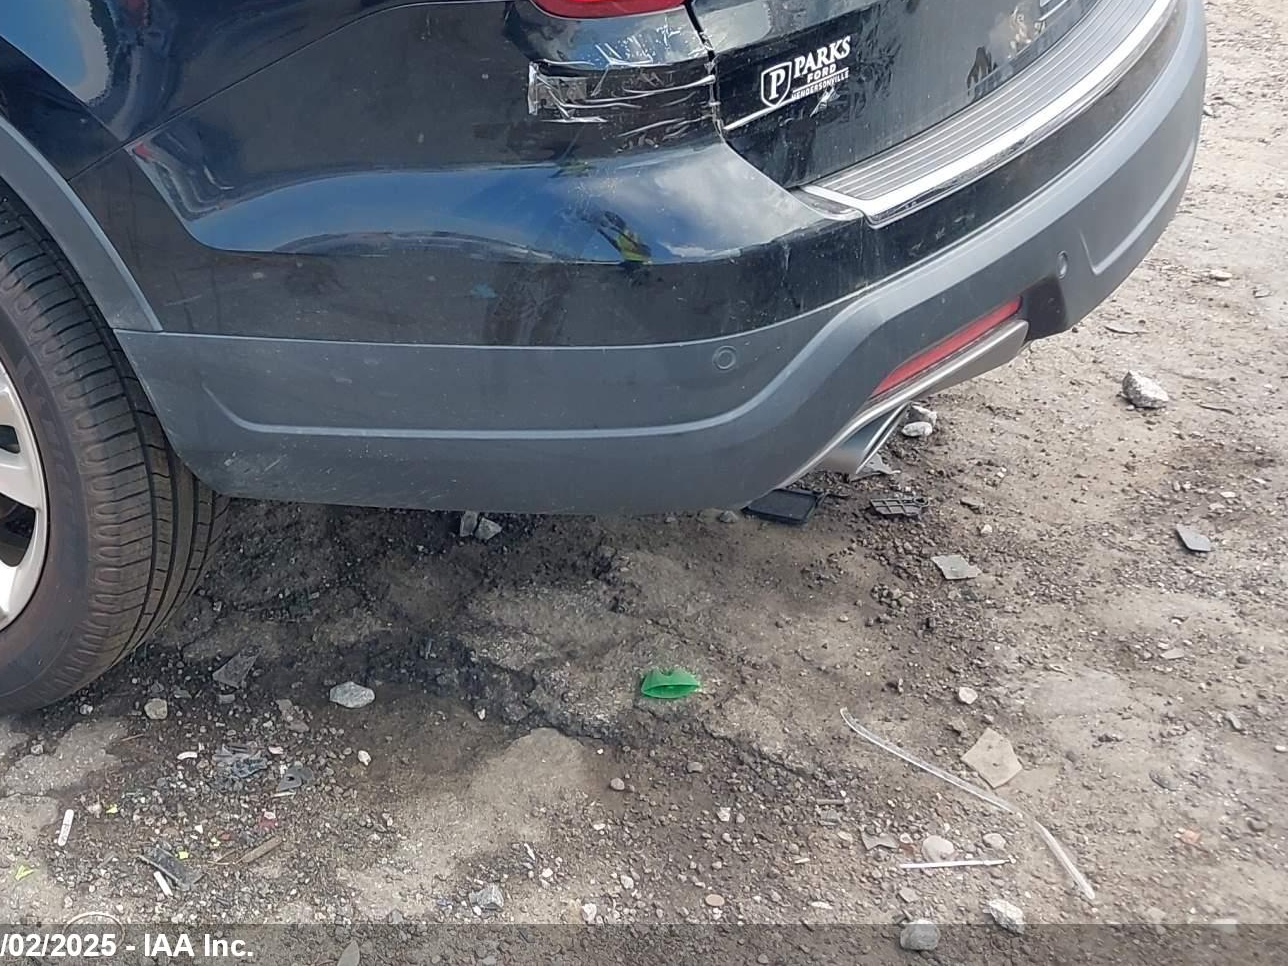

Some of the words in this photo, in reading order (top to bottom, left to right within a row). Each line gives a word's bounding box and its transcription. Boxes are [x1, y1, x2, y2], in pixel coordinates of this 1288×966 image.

[793, 35, 851, 79] PARKS
[768, 68, 786, 101] P
[791, 70, 850, 100] HENDERSONVILLE
[806, 63, 837, 84] FORD
